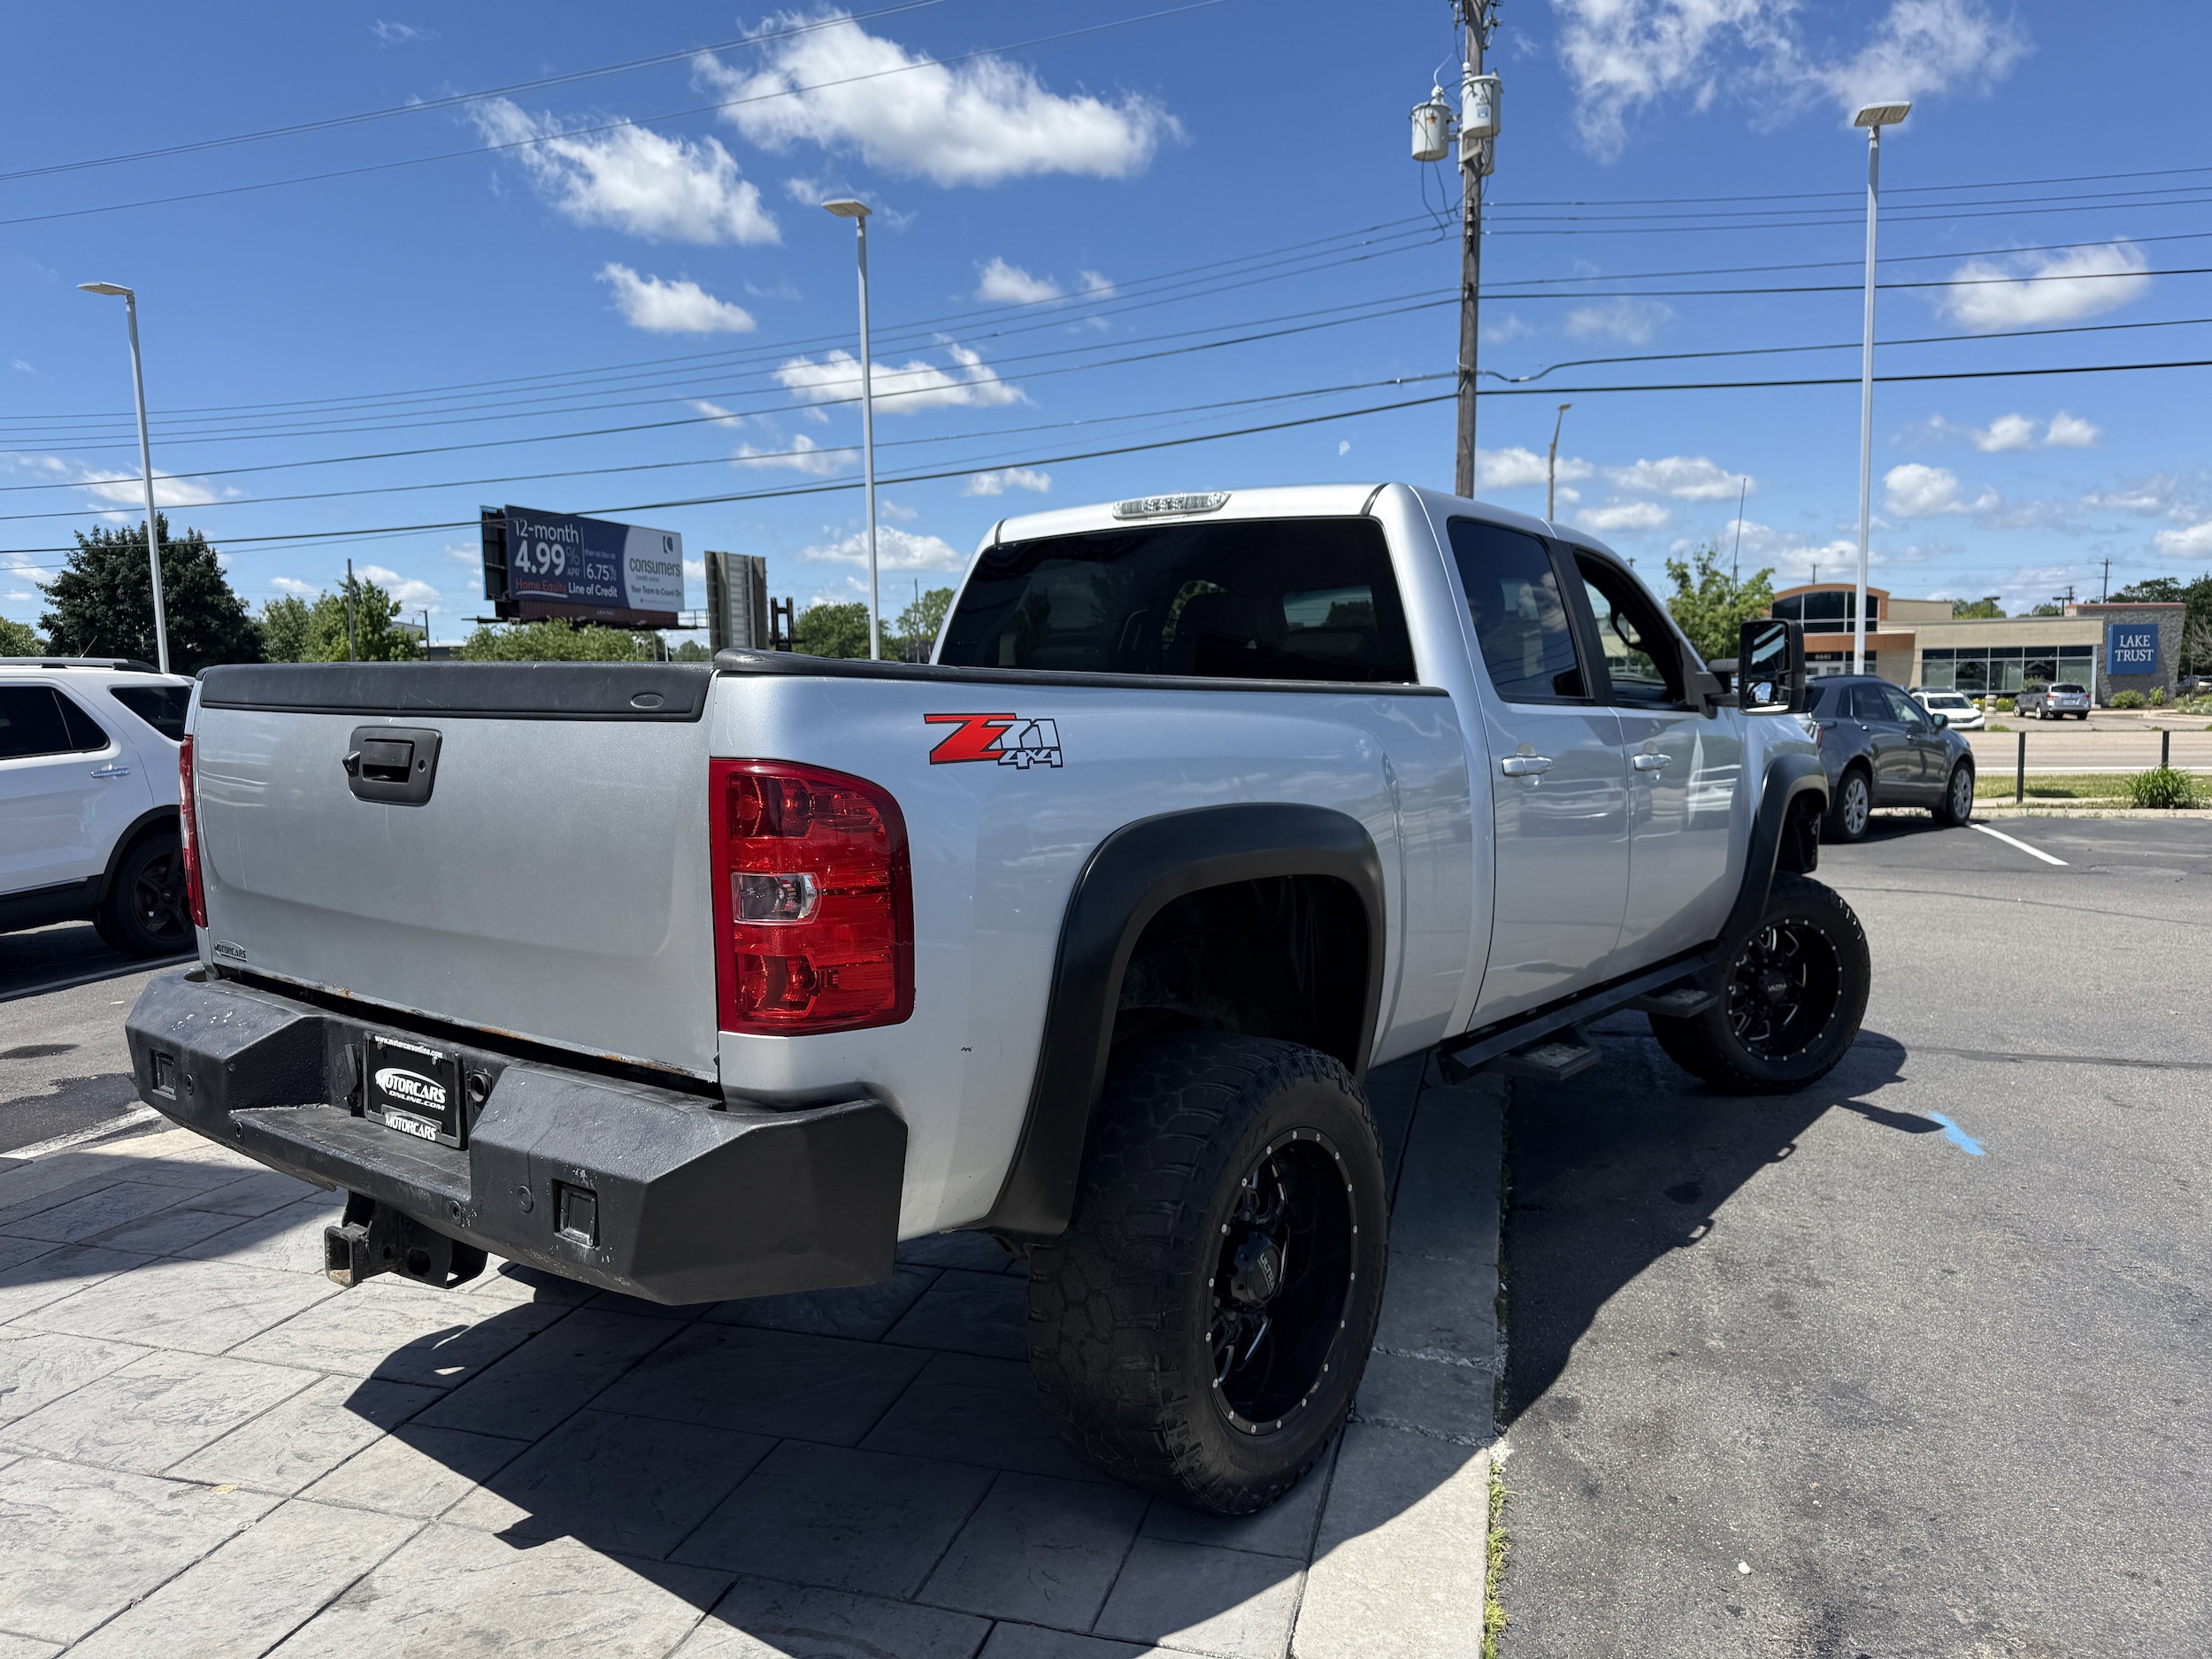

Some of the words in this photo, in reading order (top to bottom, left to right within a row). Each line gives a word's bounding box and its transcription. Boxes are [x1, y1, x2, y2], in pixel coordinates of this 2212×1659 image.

[514, 519, 580, 544] 12-month
[567, 567, 580, 578] APR
[629, 557, 681, 578] consumers
[515, 578, 541, 591] Home
[542, 580, 567, 594] Equity
[568, 582, 585, 595] Line
[586, 584, 594, 595] of
[595, 584, 618, 598] Credit
[2119, 634, 2151, 648] LAKE
[2115, 649, 2154, 662] TRUST
[924, 712, 1062, 765] Z71
[215, 943, 247, 959] MOTORCARS
[374, 1035, 443, 1060] www.motorcarsonline.com
[376, 1071, 446, 1104] MOTORCARS
[389, 1090, 445, 1111] ONLINE.COM
[385, 1115, 437, 1141] MOTORCARS
[1259, 1251, 1275, 1292] ULTRA
